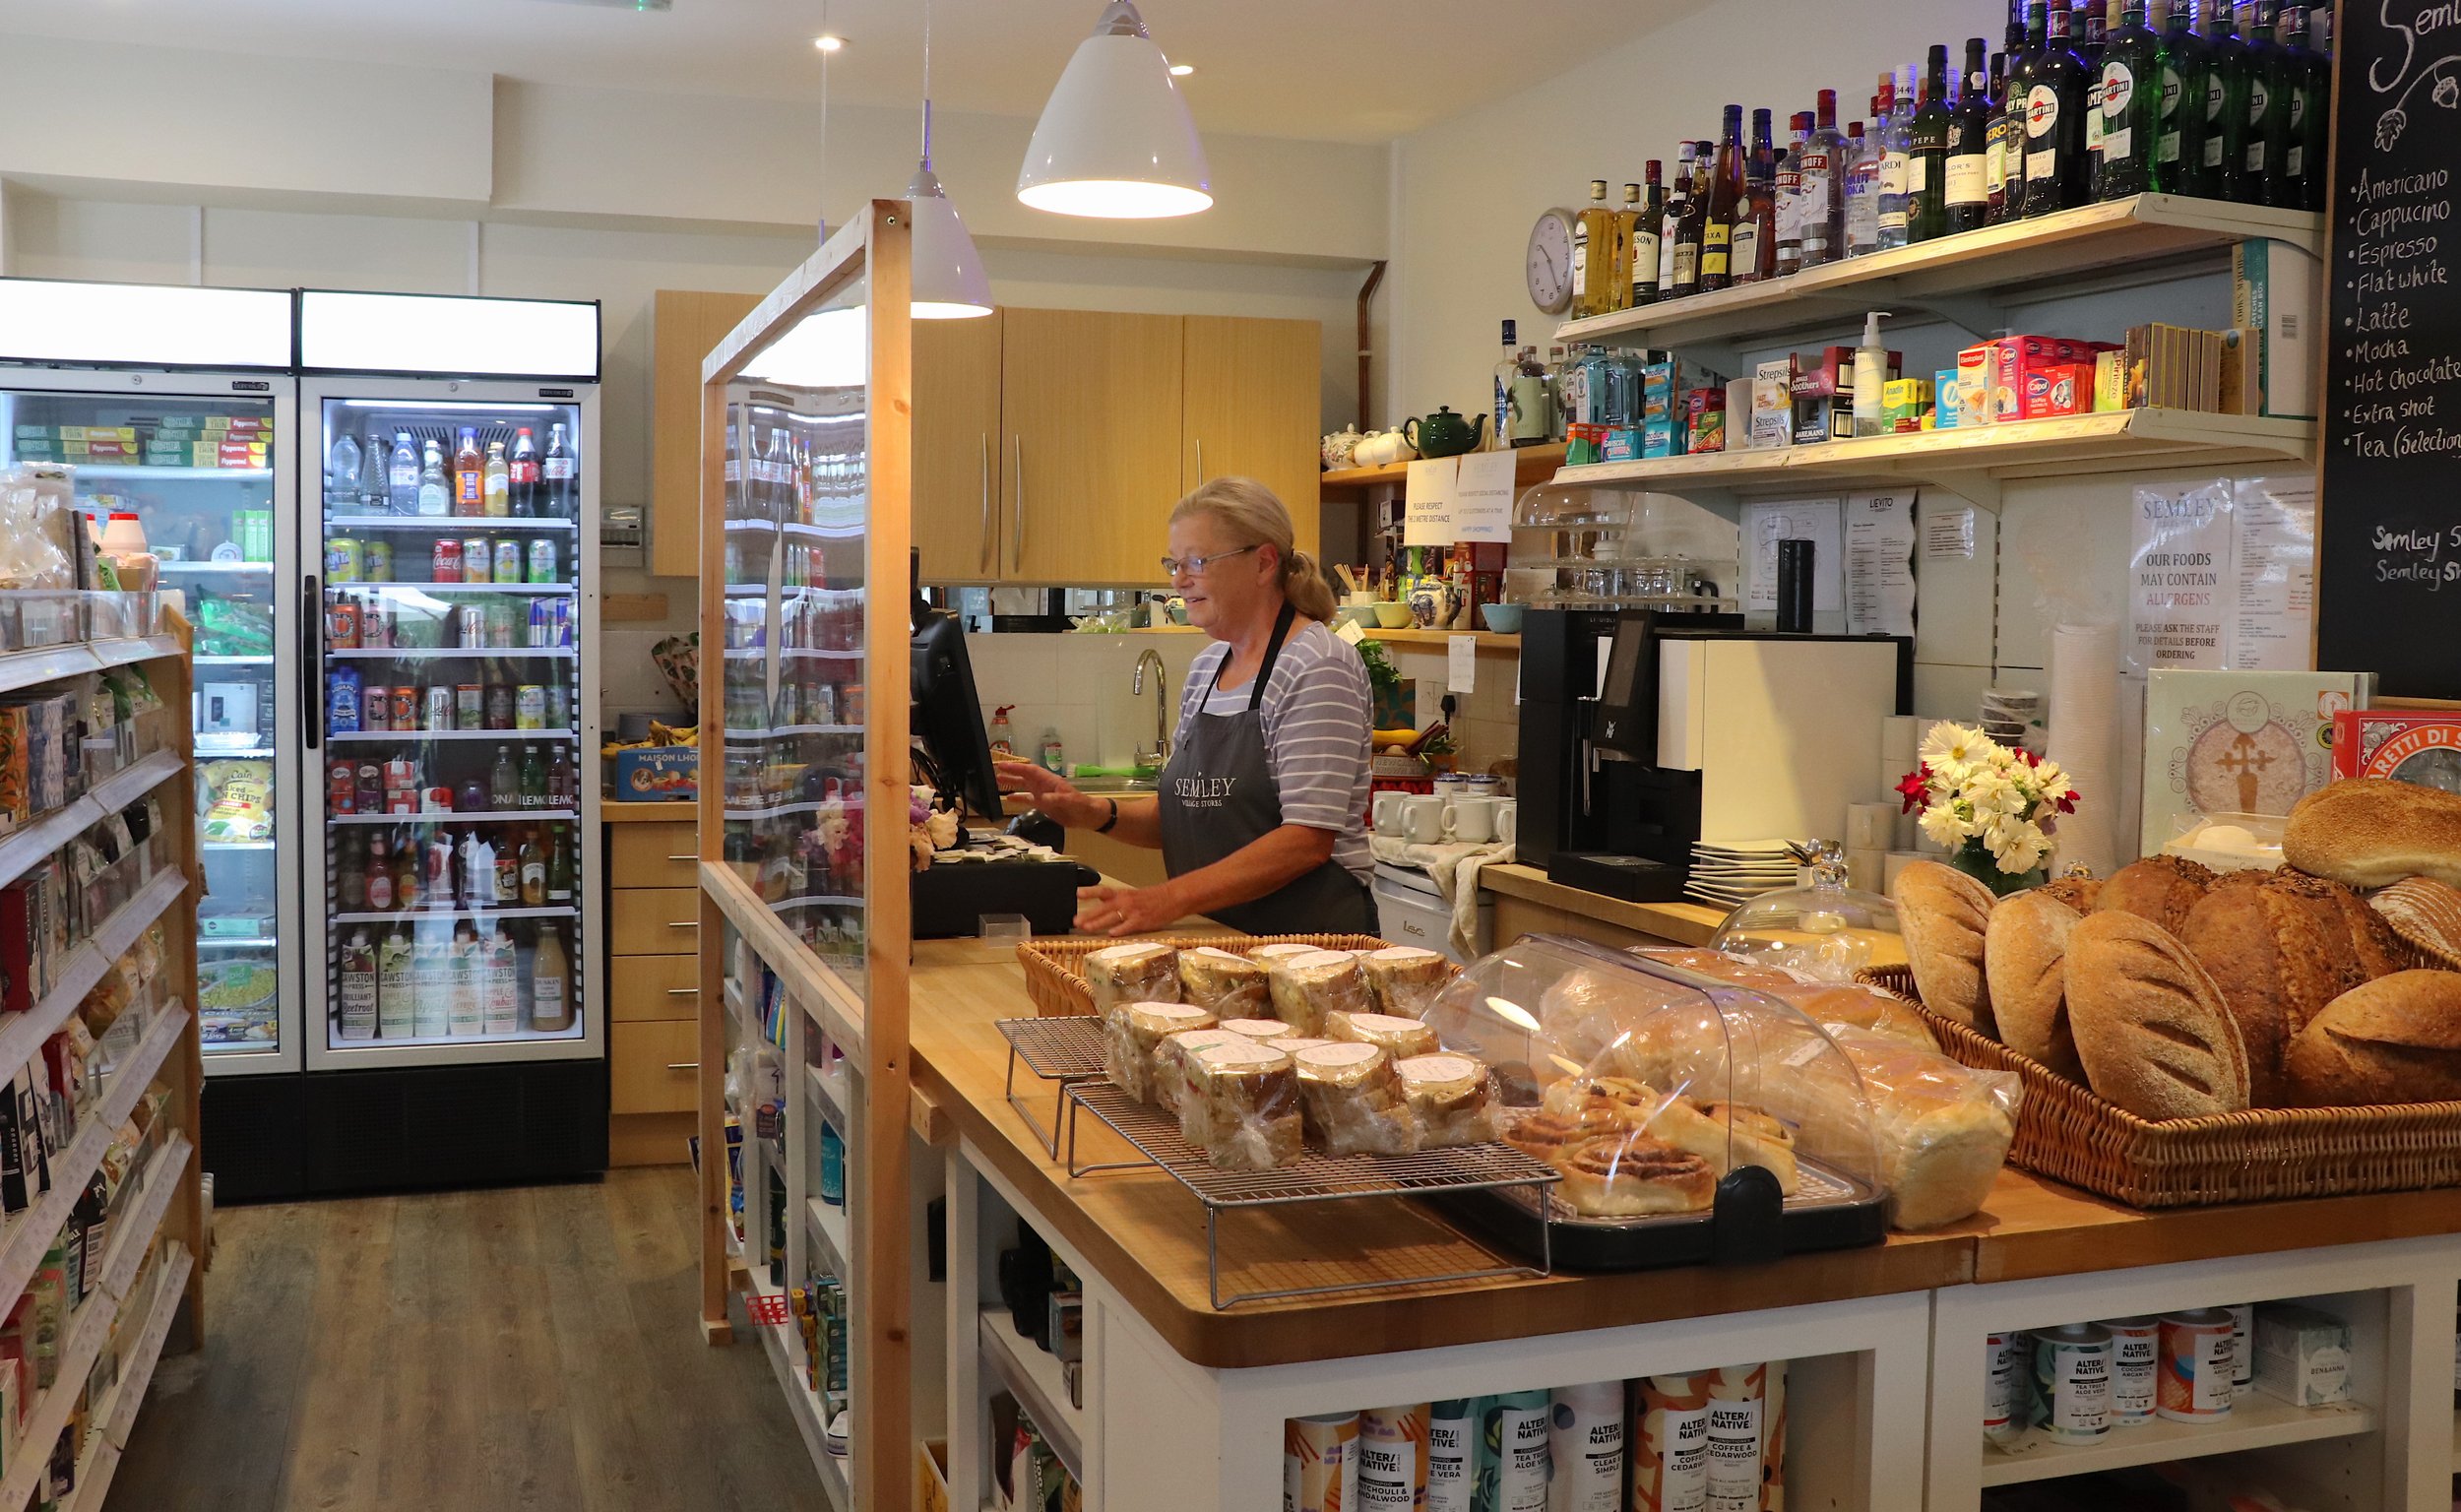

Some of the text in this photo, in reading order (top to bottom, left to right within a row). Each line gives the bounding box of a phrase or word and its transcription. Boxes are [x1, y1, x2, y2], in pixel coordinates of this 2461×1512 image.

[2368, 0, 2461, 93] Seml
[1987, 124, 2007, 141] PERO
[1913, 136, 1935, 145] PEPE
[1880, 159, 1901, 170] ARDI
[1946, 162, 1971, 172] LOR'S
[1847, 184, 1865, 195] ODKA
[2357, 167, 2448, 204] Americano
[2357, 197, 2451, 238] Cappucino
[1634, 235, 1653, 245] ESON
[2357, 235, 2437, 268] Espresso
[2357, 259, 2448, 303] Flat white
[2356, 302, 2411, 333] Latte
[2355, 339, 2410, 364] Mocha
[1759, 366, 1790, 381] Strepsils
[2112, 358, 2123, 399] Piriteze
[2354, 355, 2461, 394] Hot Chocolate
[1791, 381, 1819, 392] Soothers
[2029, 382, 2049, 392] Calpol
[2353, 396, 2435, 424] Extra shot
[1755, 414, 1785, 427] Strepsils
[2352, 432, 2390, 459] Tea
[2143, 497, 2217, 520] SEMLEY
[1428, 514, 1450, 523] DISTANCE
[2372, 525, 2439, 563] Semley
[2146, 552, 2212, 567] OUR FOODS
[2140, 572, 2217, 587] MAY CONTAIN
[2146, 593, 2211, 606] ALLERGENS
[2135, 623, 2221, 633] PLEASE ASK THE STAFF
[2138, 637, 2216, 647] FOR DETAILS BEFORE
[2156, 650, 2195, 660] ORDERING
[2367, 728, 2448, 783] ARETTI DI
[1174, 778, 1236, 798] SEMLEY
[231, 792, 262, 804] CHIPS
[1679, 1418, 1706, 1431] ALTER
[1711, 1419, 1749, 1429] NATIVE
[1430, 1429, 1454, 1438] TER/
[1589, 1431, 1622, 1444] NATIVE
[1430, 1438, 1455, 1448] TIVE
[1593, 1458, 1617, 1467] CLEAR
[1671, 1459, 1707, 1472] CEDARW
[1595, 1464, 1619, 1475] SIMPLE
[1358, 1490, 1410, 1502] ANDALWOOD
